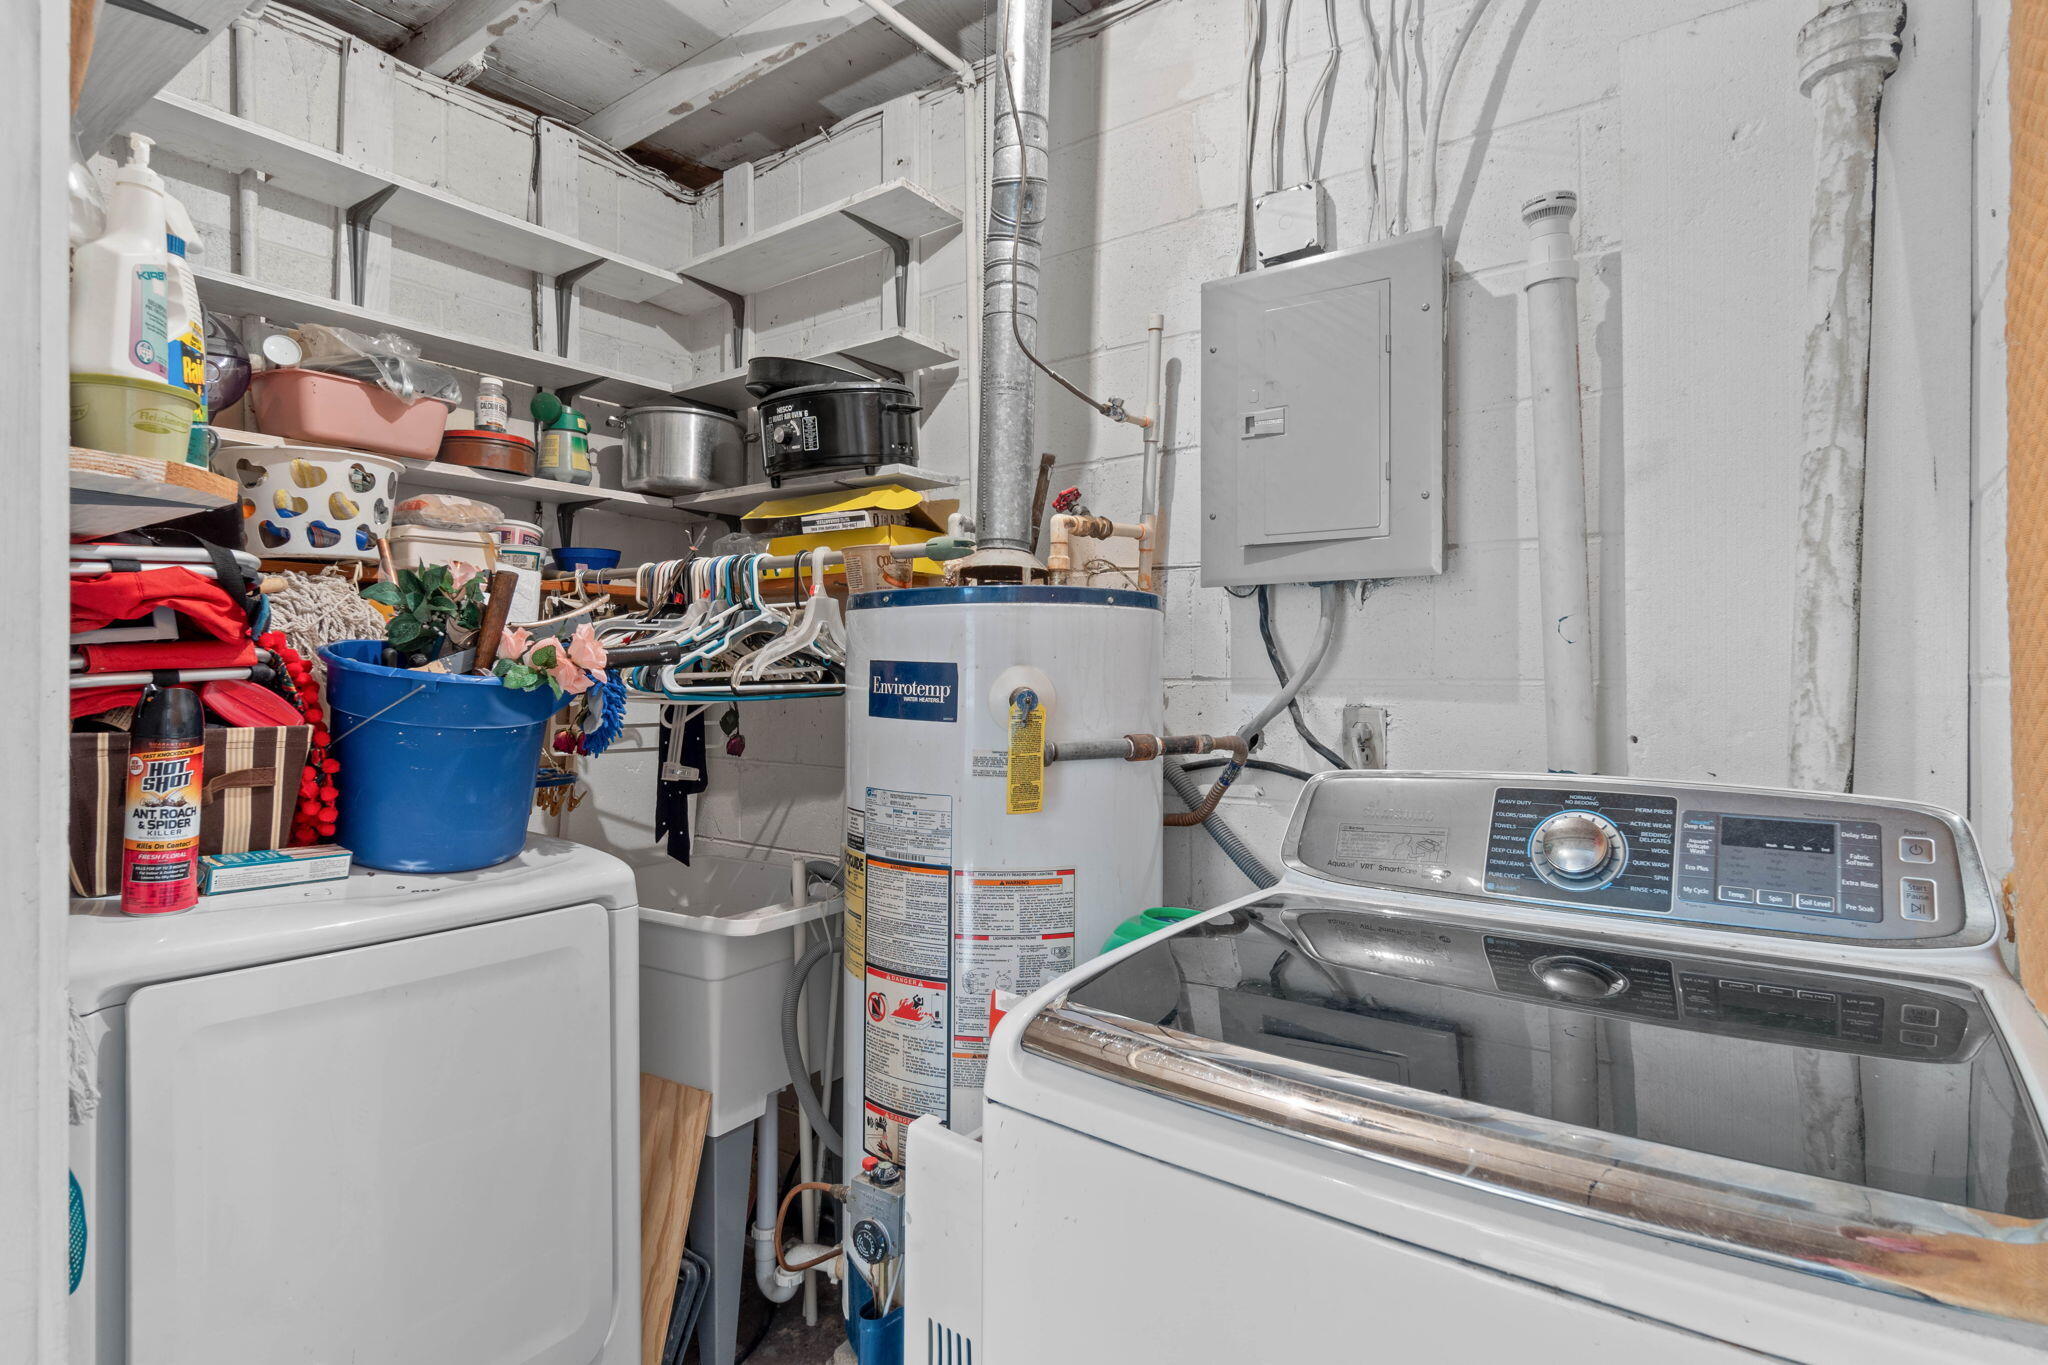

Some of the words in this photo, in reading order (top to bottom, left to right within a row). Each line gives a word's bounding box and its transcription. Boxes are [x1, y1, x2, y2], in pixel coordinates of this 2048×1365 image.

[136, 271, 167, 280] KIRB
[776, 405, 792, 413] NESCO
[873, 675, 950, 703] Envirotemp
[157, 749, 194, 757] KNOCKDOWN
[149, 758, 188, 777] HOT
[142, 772, 193, 793] SHOT
[132, 808, 157, 820] ANT,
[160, 807, 197, 819] ROACH
[138, 821, 145, 829] &
[147, 818, 191, 829] SPIDER
[1841, 831, 1860, 840] Delay
[1861, 832, 1878, 840] Start
[1849, 853, 1870, 861] Fabric
[1489, 859, 1525, 867] DENIM/JEANS
[1845, 859, 1874, 867] Softener
[1378, 864, 1418, 874] SmartCare
[1841, 879, 1859, 887] Extra
[1860, 881, 1879, 889] Rinse
[1907, 883, 1928, 891] Start
[1683, 886, 1692, 894] My
[1728, 891, 1746, 899] Temp.
[1768, 895, 1783, 903] Spin
[1814, 900, 1832, 908] Level
[1906, 892, 1929, 900] Pause
[1858, 905, 1875, 913] Soak
[891, 975, 917, 985] DANGER
[890, 1114, 911, 1125] DANGE
